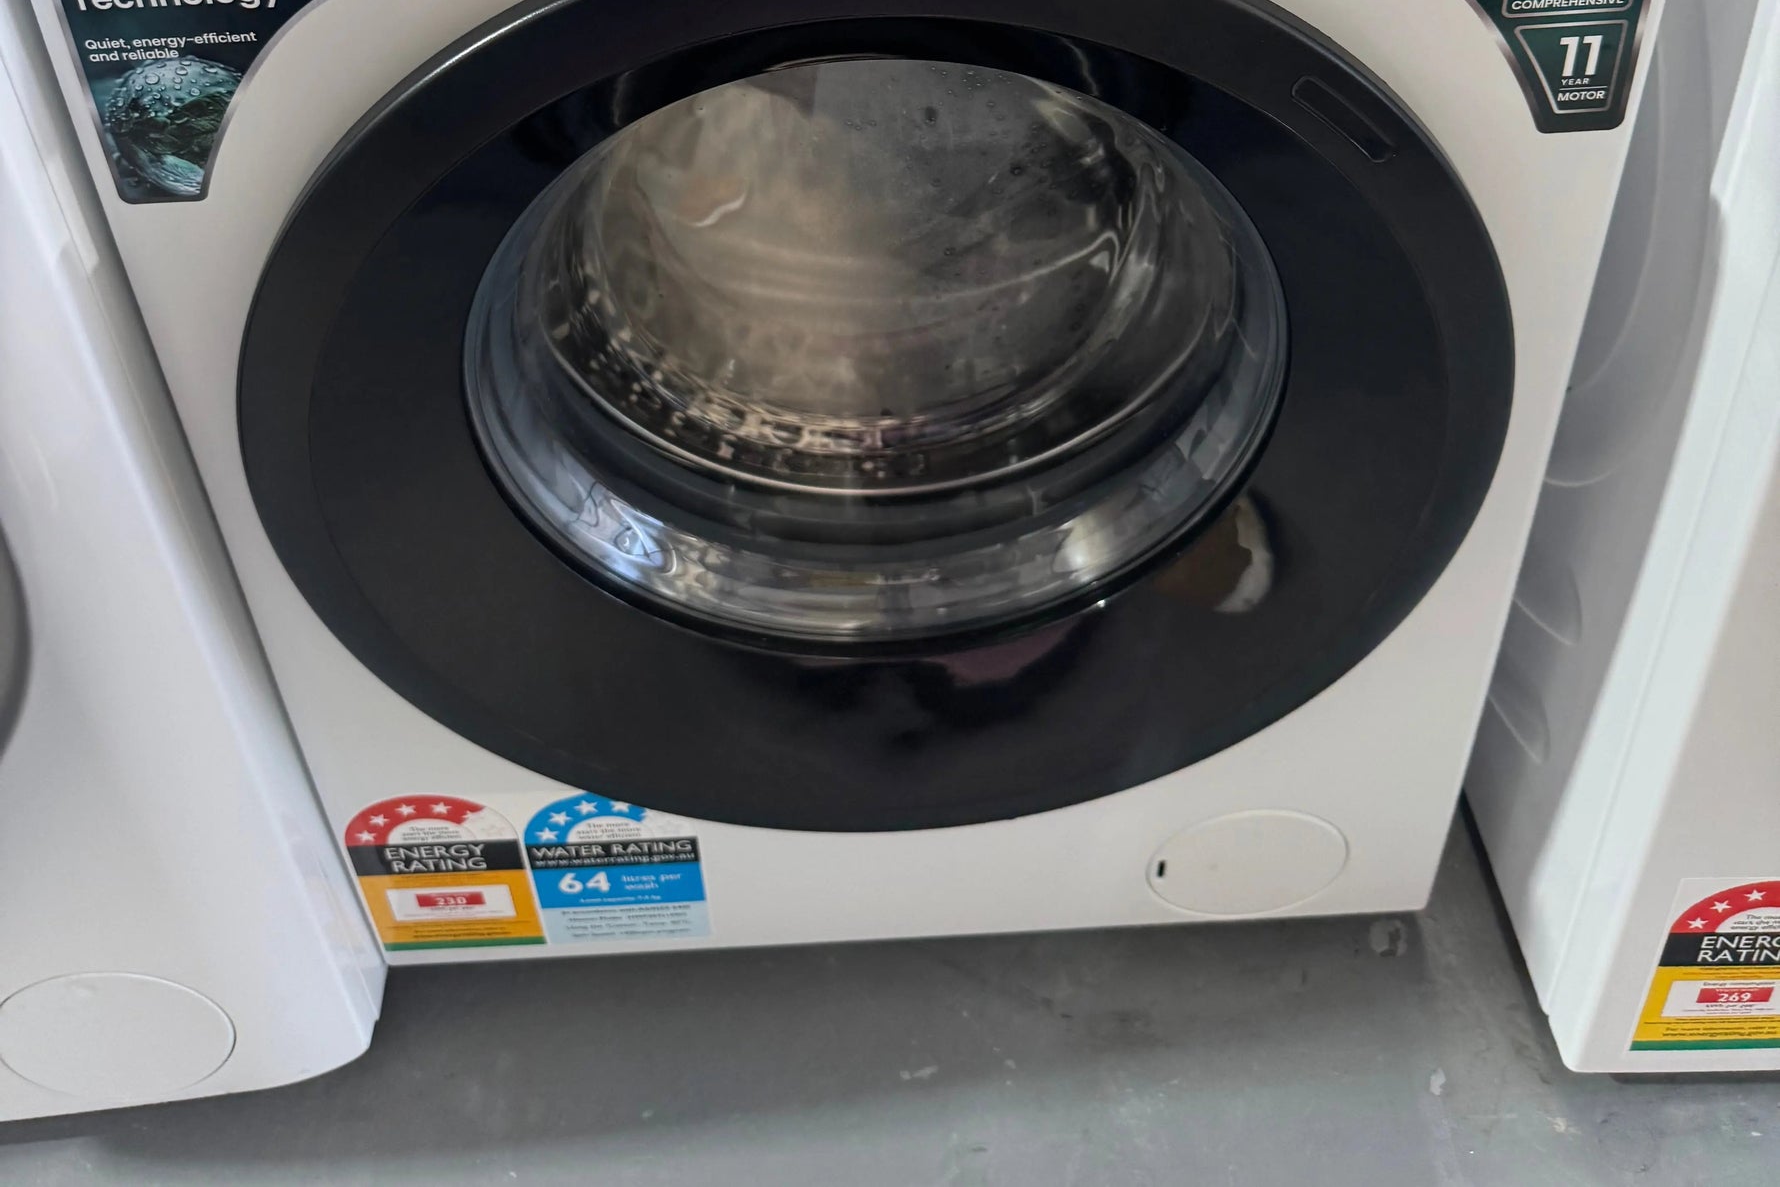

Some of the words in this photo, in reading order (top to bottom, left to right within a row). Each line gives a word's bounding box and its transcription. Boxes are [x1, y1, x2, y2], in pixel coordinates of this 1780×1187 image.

[85, 38, 130, 50] Quiet,
[133, 32, 257, 50] energy-efficient
[90, 52, 119, 62] and
[123, 48, 179, 61] reliable
[1560, 36, 1604, 76] 11
[1562, 78, 1590, 86] YEAR
[1557, 91, 1605, 101] MOTOR
[385, 844, 485, 860] ENERGY
[532, 845, 605, 858] WATER
[611, 841, 692, 855] RATING
[392, 857, 487, 872] RATING
[558, 871, 611, 894] 64
[1717, 993, 1752, 1002] 269
